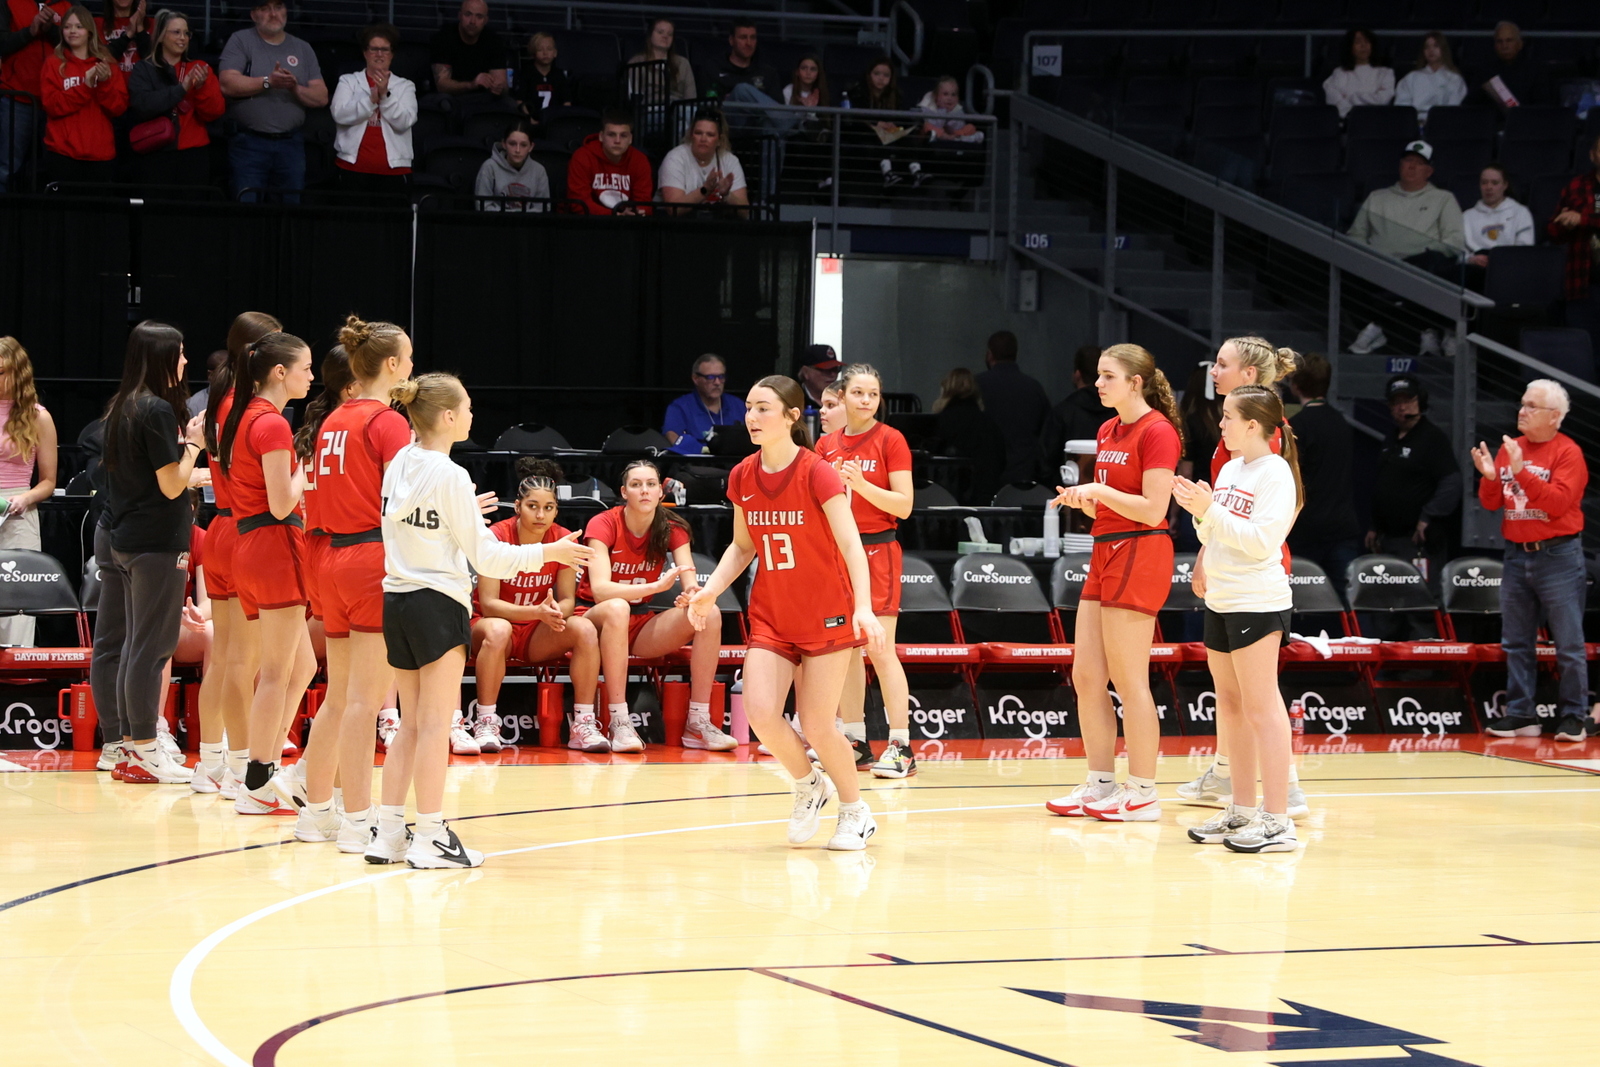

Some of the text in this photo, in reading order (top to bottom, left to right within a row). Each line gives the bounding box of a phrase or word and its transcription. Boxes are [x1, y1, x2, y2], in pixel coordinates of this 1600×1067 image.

[1036, 55, 1058, 67] 107
[538, 90, 552, 109] 7
[1025, 233, 1048, 248] 106
[1391, 358, 1412, 372] 107
[319, 430, 348, 475] 24
[747, 510, 804, 525] BELLEVUE
[762, 533, 796, 571] 13
[0, 569, 60, 582] reSource
[900, 574, 934, 583] ource
[963, 570, 1032, 584] CareSource
[1288, 573, 1325, 585] Source
[1358, 572, 1420, 584] CareSource
[1452, 575, 1502, 587] CareSour
[14, 652, 85, 661] DAYTON FLYERS
[1012, 648, 1072, 656] DAYTON FLYERS
[1150, 647, 1174, 655] LYERS
[1412, 646, 1468, 654] DAYTON FLYERS
[78, 692, 86, 719] FREITAG
[1301, 691, 1366, 734] Kroger
[988, 695, 1068, 738] Kroger
[1389, 697, 1462, 734] Kroger
[0, 702, 73, 749] Kroge
